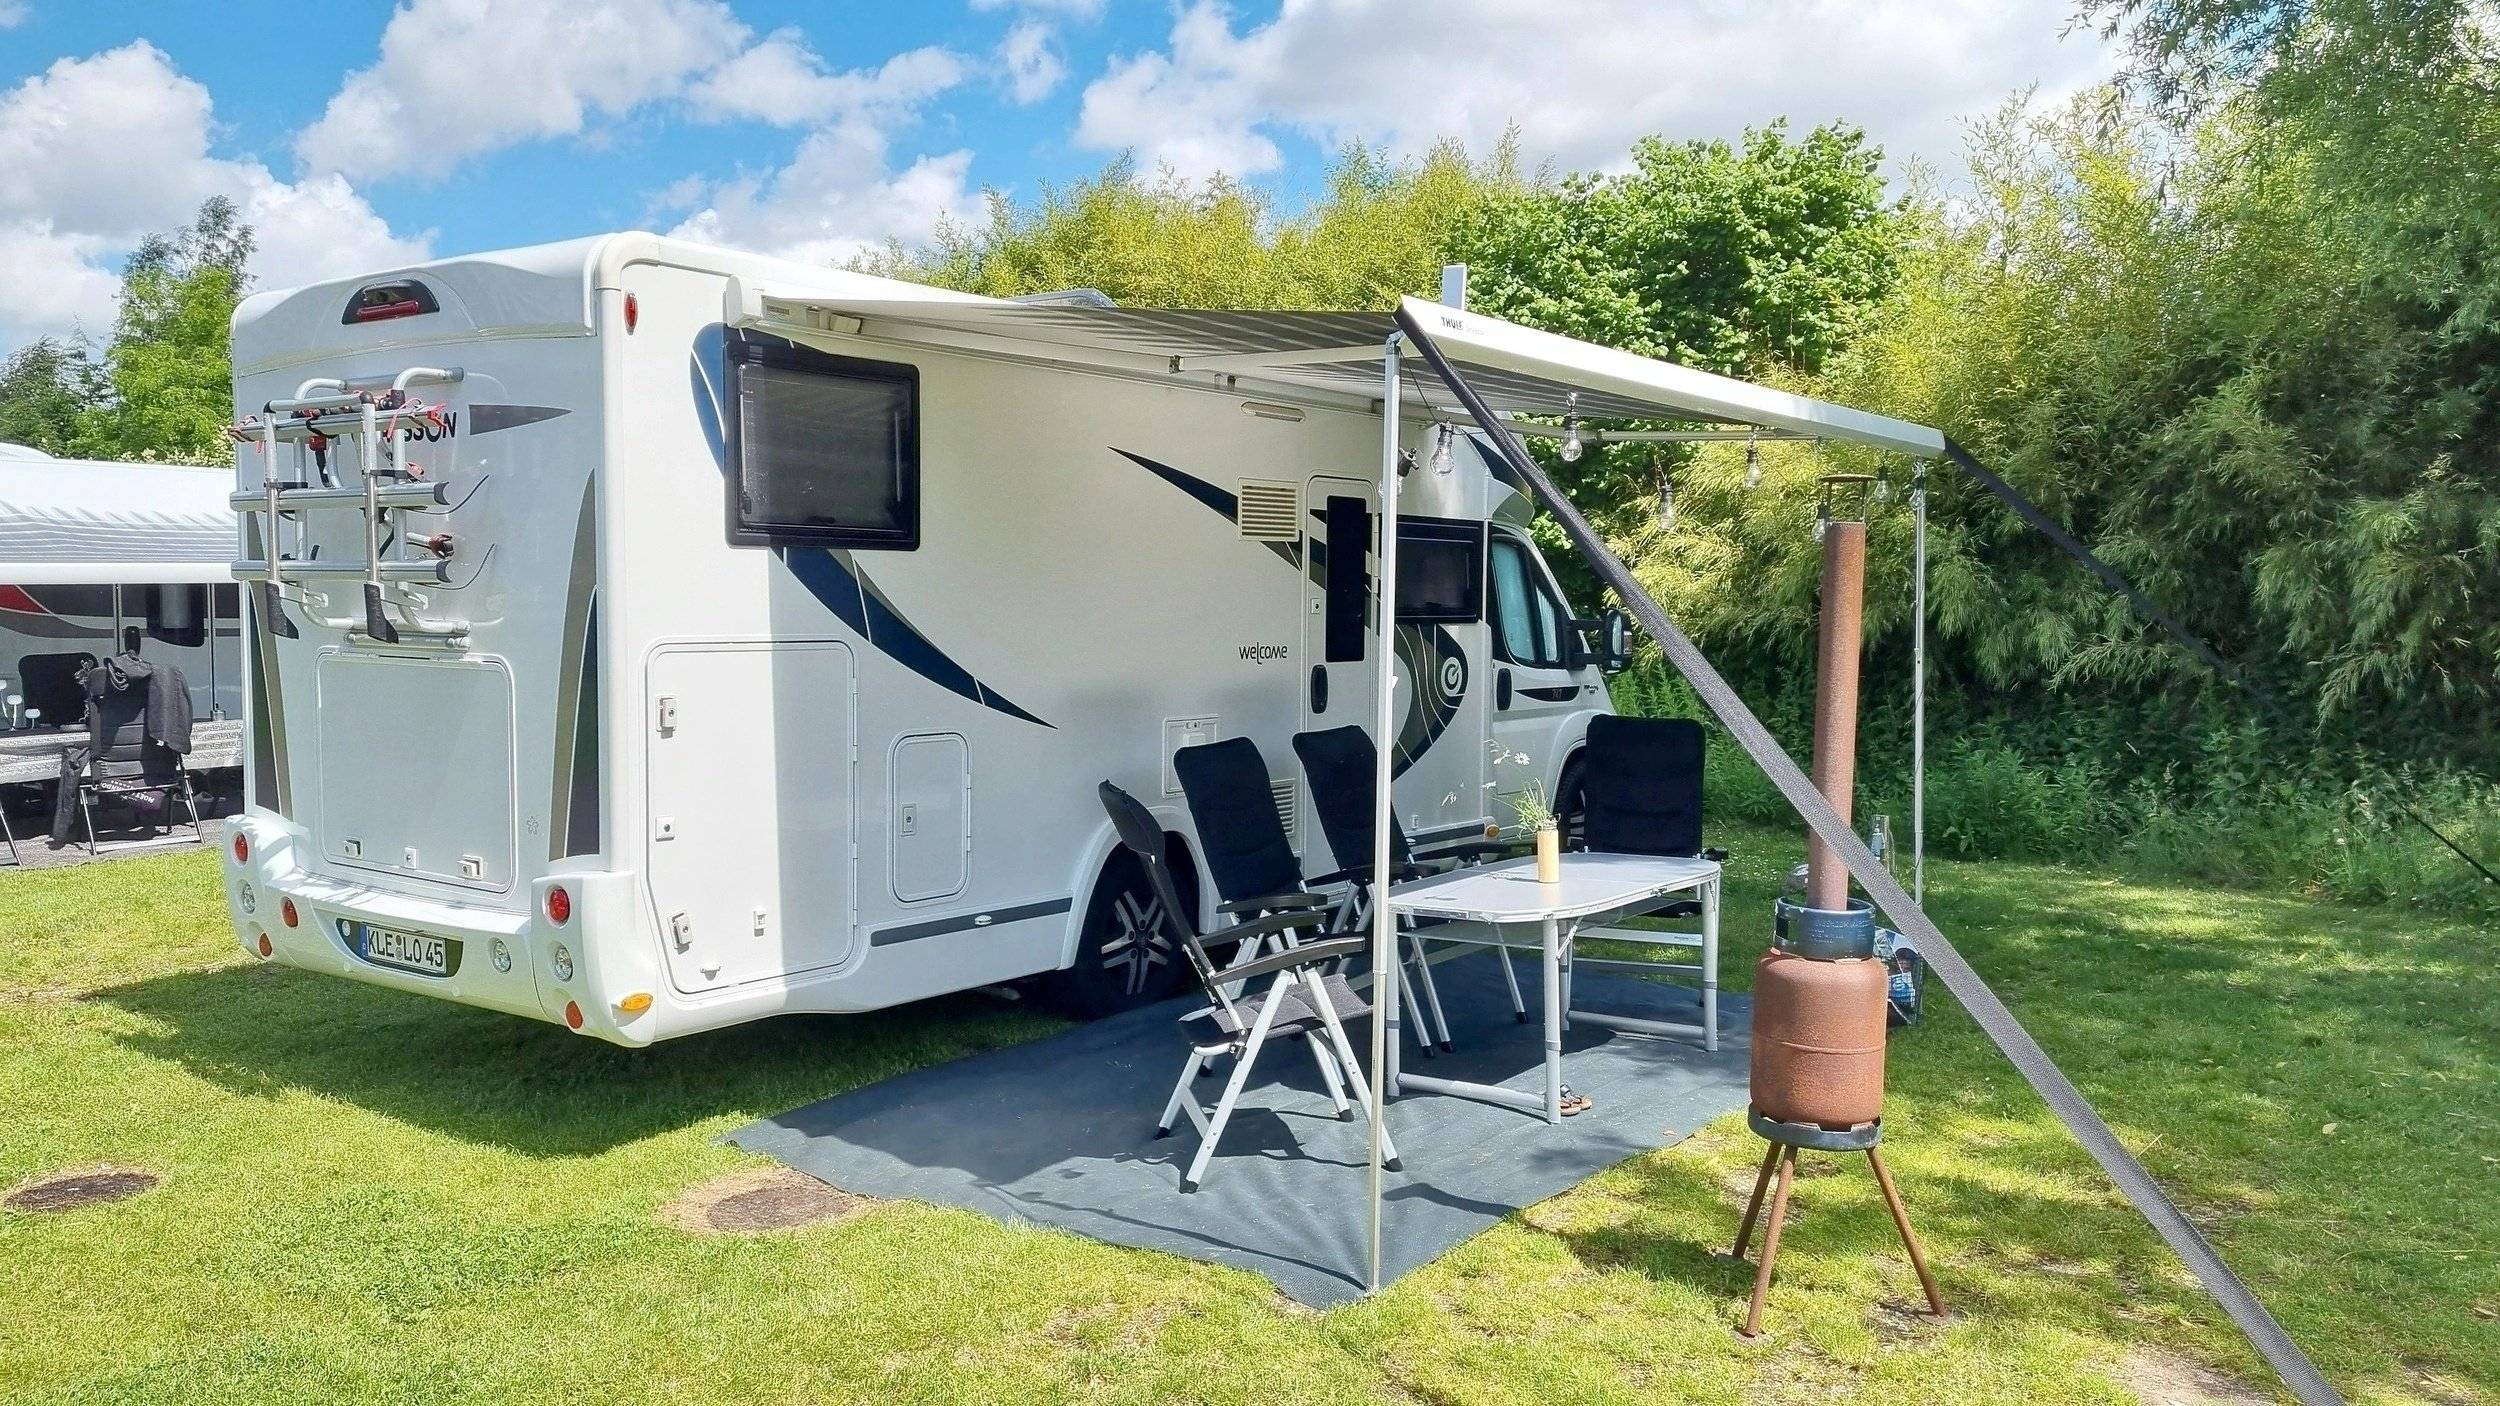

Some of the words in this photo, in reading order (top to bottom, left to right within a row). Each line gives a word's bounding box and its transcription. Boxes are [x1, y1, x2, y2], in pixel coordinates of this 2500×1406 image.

[1441, 316, 1464, 331] THULE
[1238, 641, 1288, 665] welcome
[367, 929, 395, 958] KLE
[402, 936, 422, 964] LO
[425, 941, 444, 967] 45
